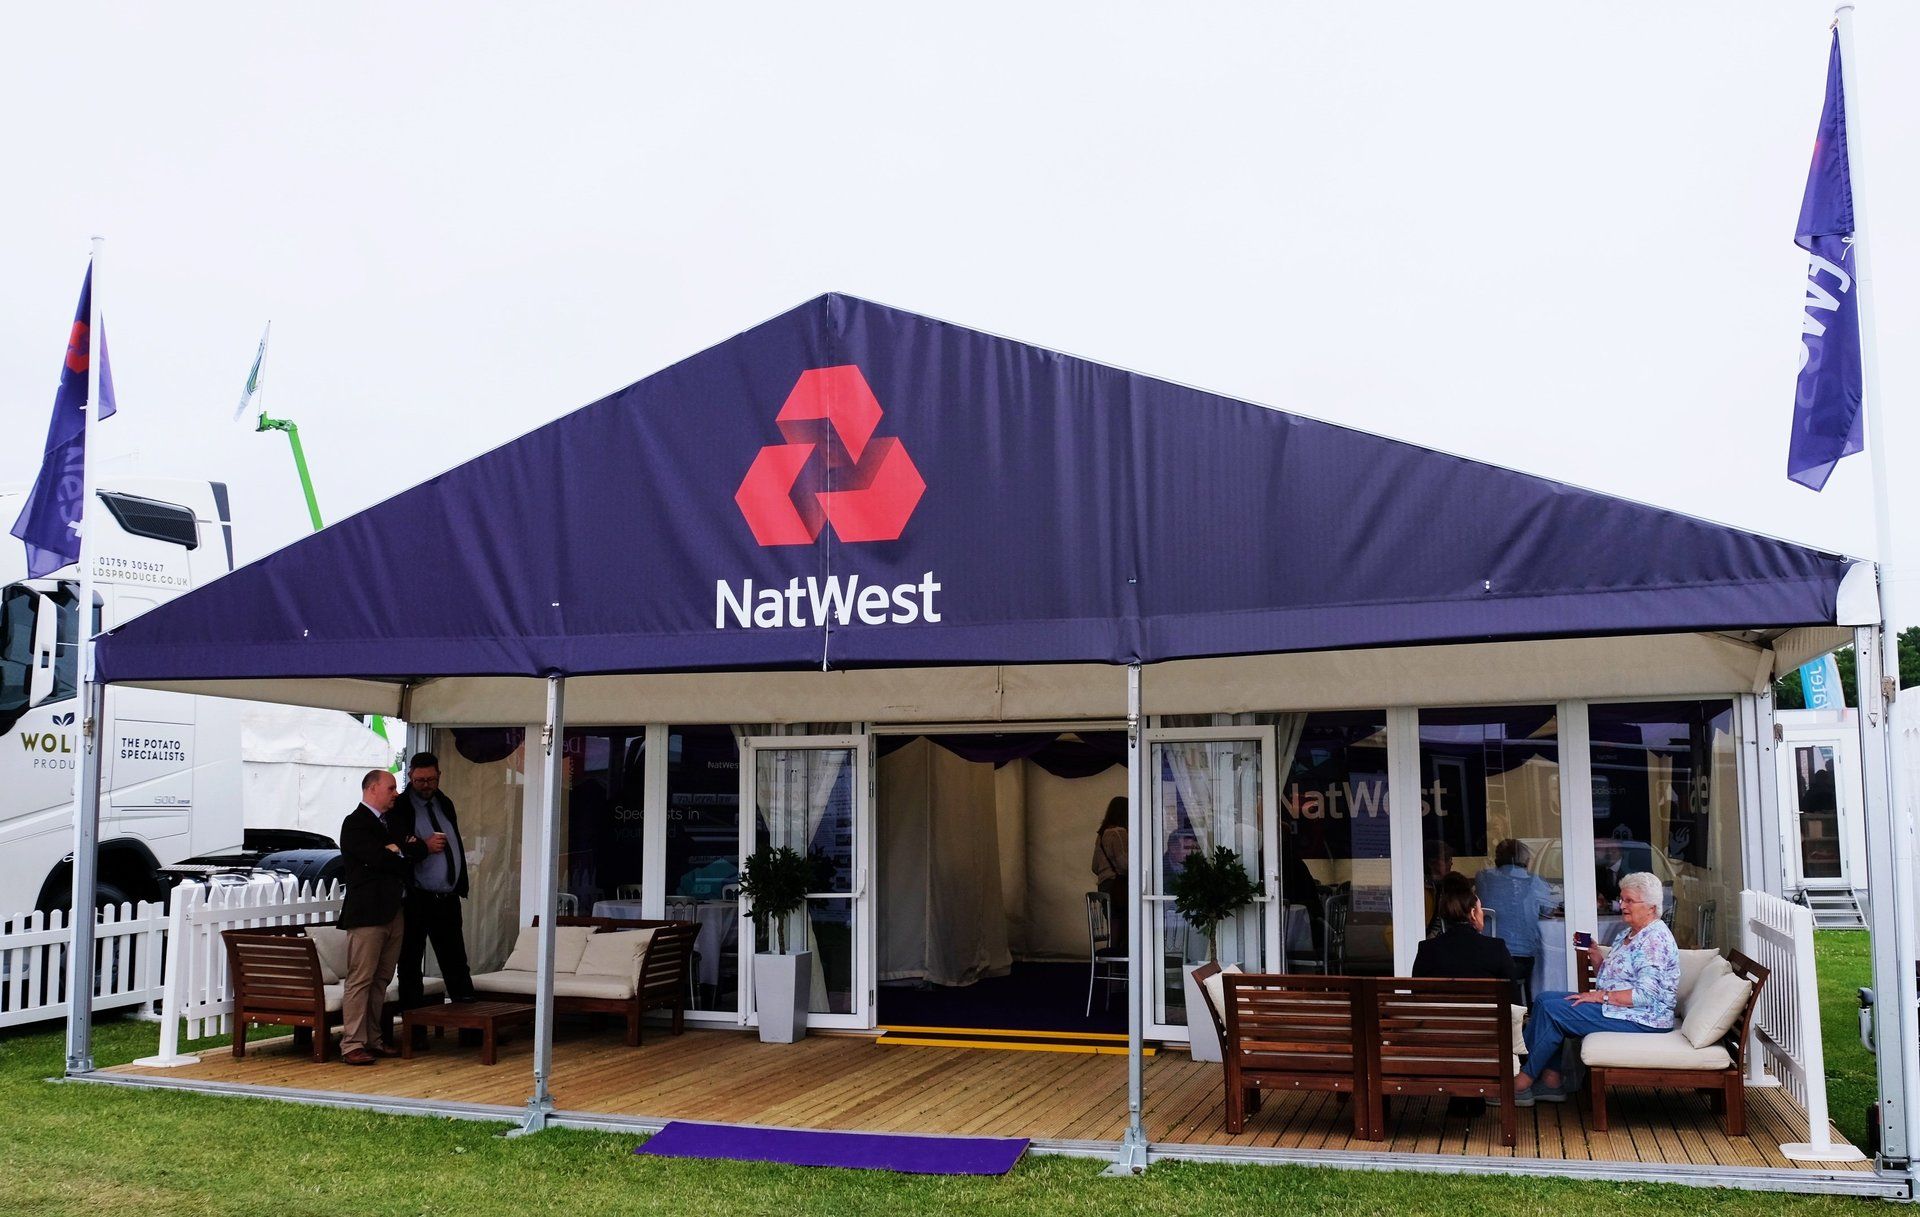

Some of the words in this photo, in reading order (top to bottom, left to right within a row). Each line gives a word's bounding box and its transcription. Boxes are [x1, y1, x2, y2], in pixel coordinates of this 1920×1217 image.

[99, 557, 128, 568] 01759
[131, 561, 165, 573] 305627
[75, 565, 189, 587] WLDSPRODUCE.CO.UK
[715, 571, 942, 629] NatWest
[20, 732, 77, 754] WOL
[121, 738, 140, 748] THE
[143, 739, 181, 750] POTATO
[120, 749, 186, 762] SPECIALISTS
[33, 758, 76, 770] PRODU
[707, 760, 739, 770] NatWes
[1281, 779, 1448, 820] NatWst
